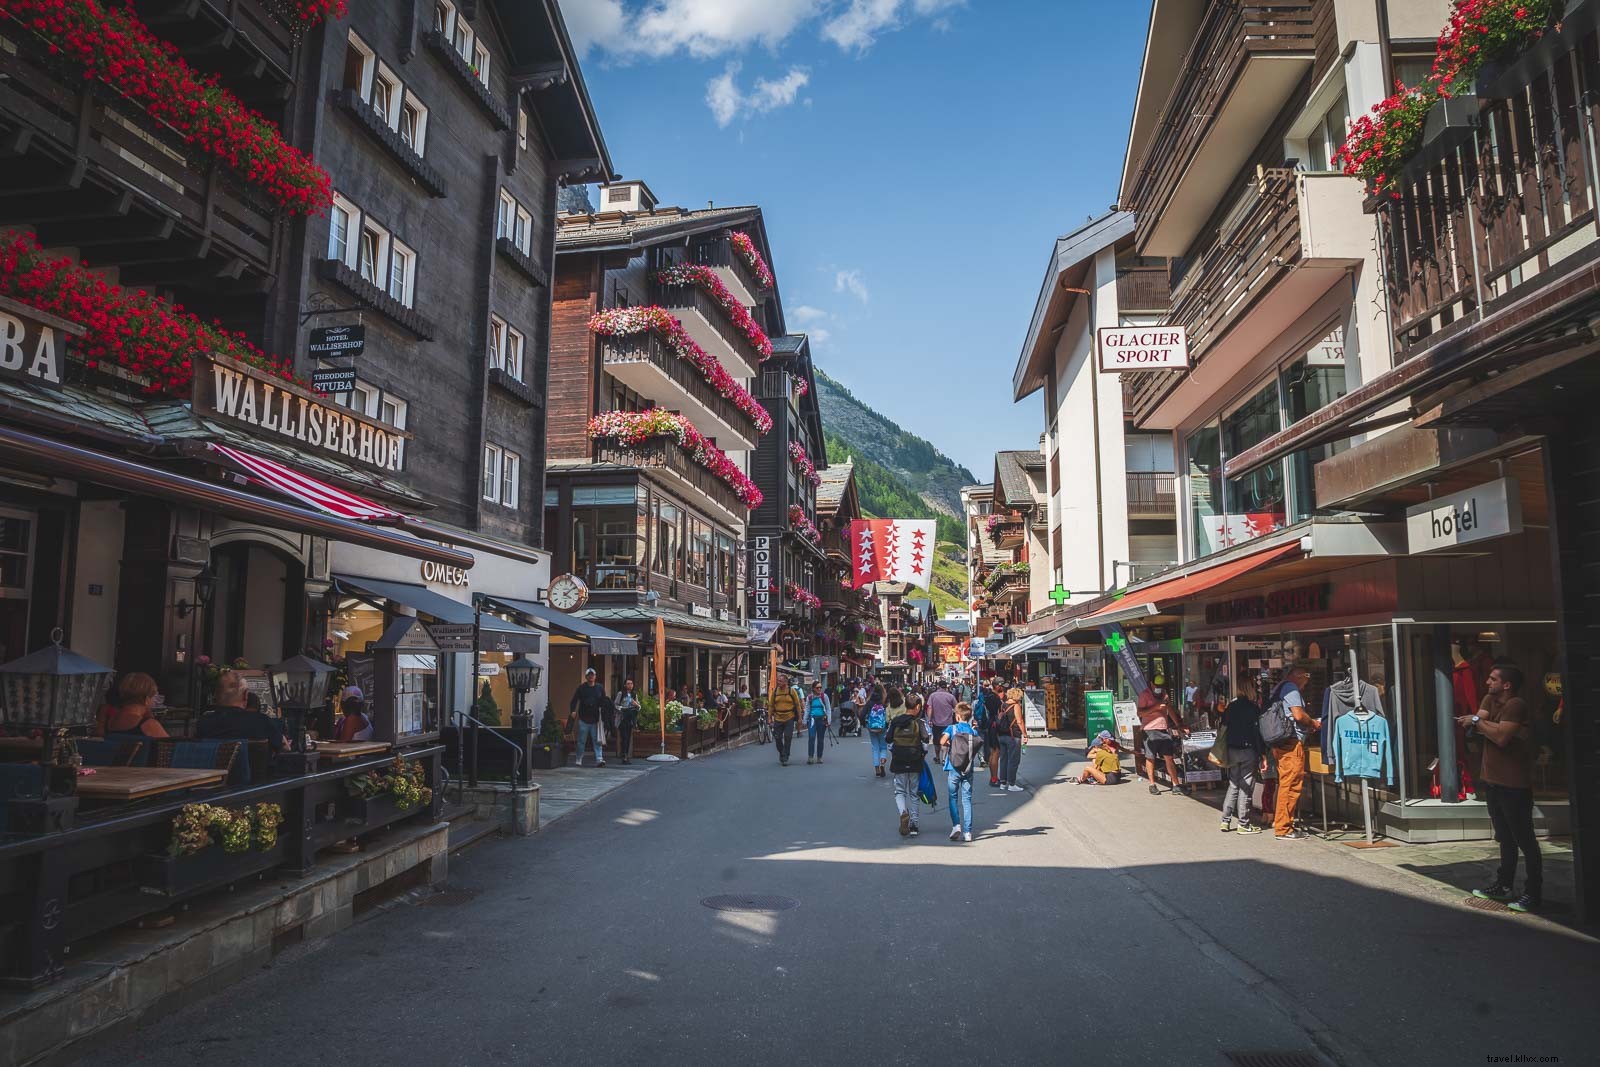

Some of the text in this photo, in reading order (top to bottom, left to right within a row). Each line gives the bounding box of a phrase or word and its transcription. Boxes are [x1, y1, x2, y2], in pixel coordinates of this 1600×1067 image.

[310, 340, 364, 351] WALLISERHOF
[326, 334, 349, 342] HOTEL
[1105, 332, 1180, 347] GLACIER
[0, 311, 60, 384] BA
[1116, 349, 1172, 364] SPORT
[313, 371, 355, 380] THEODORS
[313, 380, 354, 392] STUBA
[213, 363, 400, 471] WALLISERHOF
[1431, 498, 1478, 539] hotel
[422, 560, 470, 586] OMEGA
[756, 537, 768, 618] POLLUX
[431, 626, 472, 635] Walliserhof
